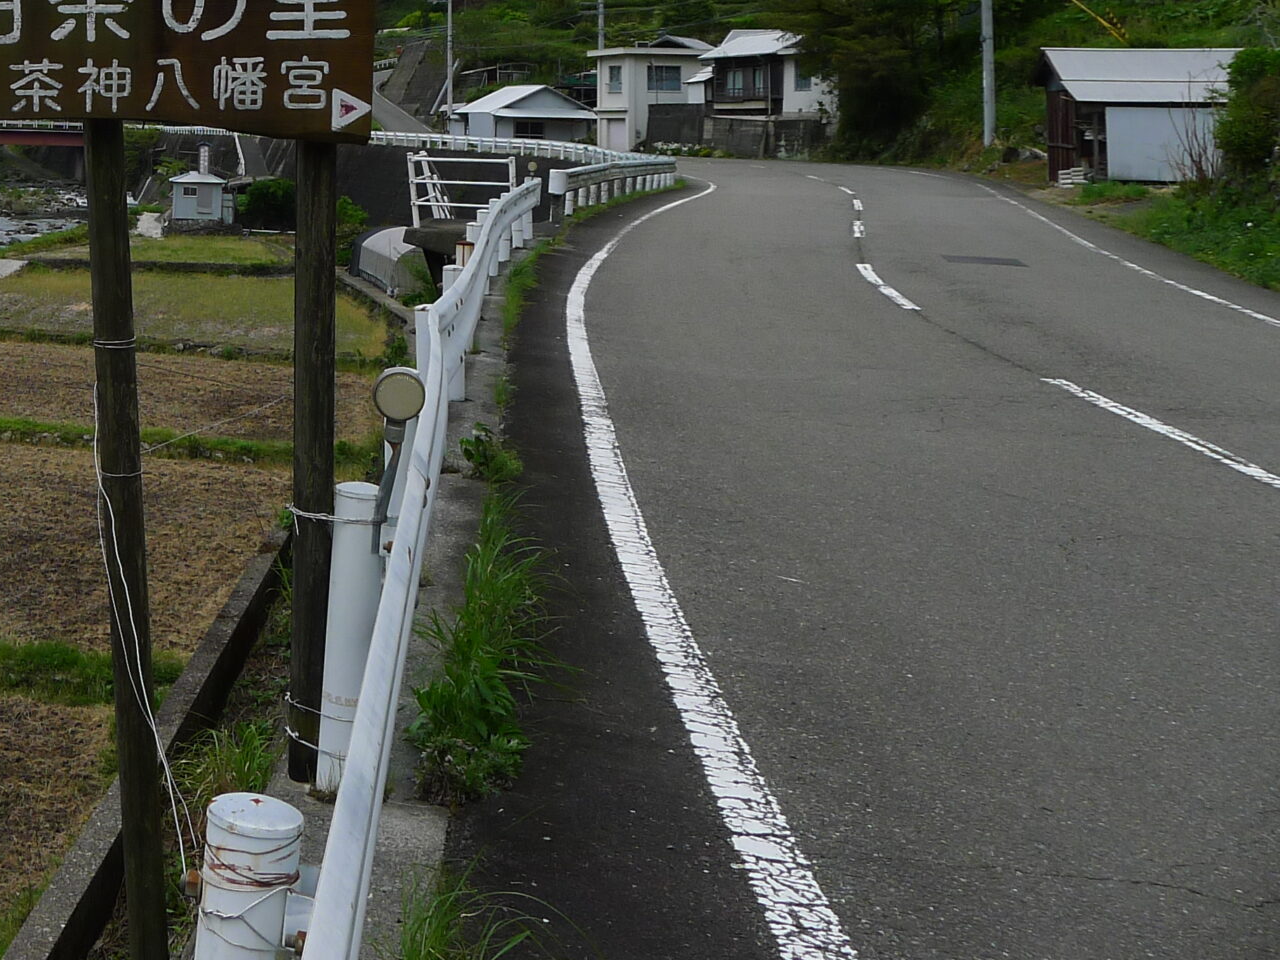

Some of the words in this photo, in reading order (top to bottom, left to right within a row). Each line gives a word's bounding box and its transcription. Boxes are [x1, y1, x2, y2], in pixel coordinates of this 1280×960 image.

[9, 56, 330, 114] 茶神八幡宮
